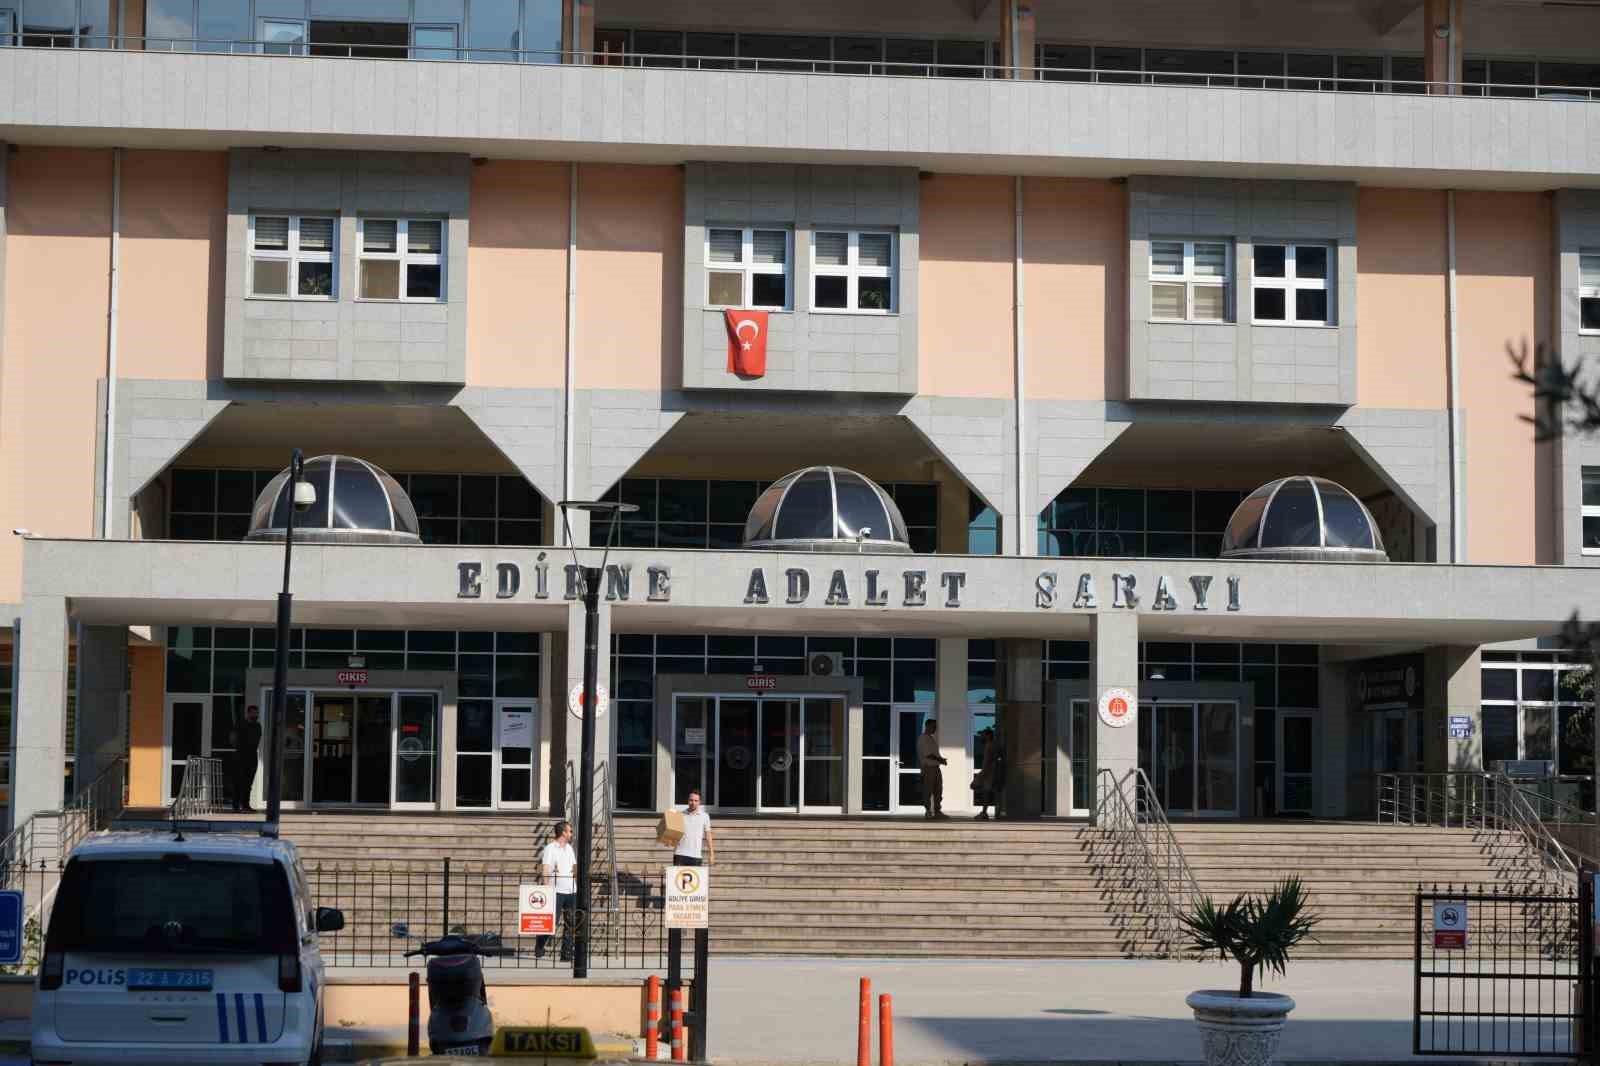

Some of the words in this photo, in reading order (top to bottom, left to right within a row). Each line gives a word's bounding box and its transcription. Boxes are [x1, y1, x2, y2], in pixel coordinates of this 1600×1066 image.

[743, 567, 966, 608] ADALET
[1035, 571, 1241, 612] SARAYI
[65, 968, 126, 986] POLiS
